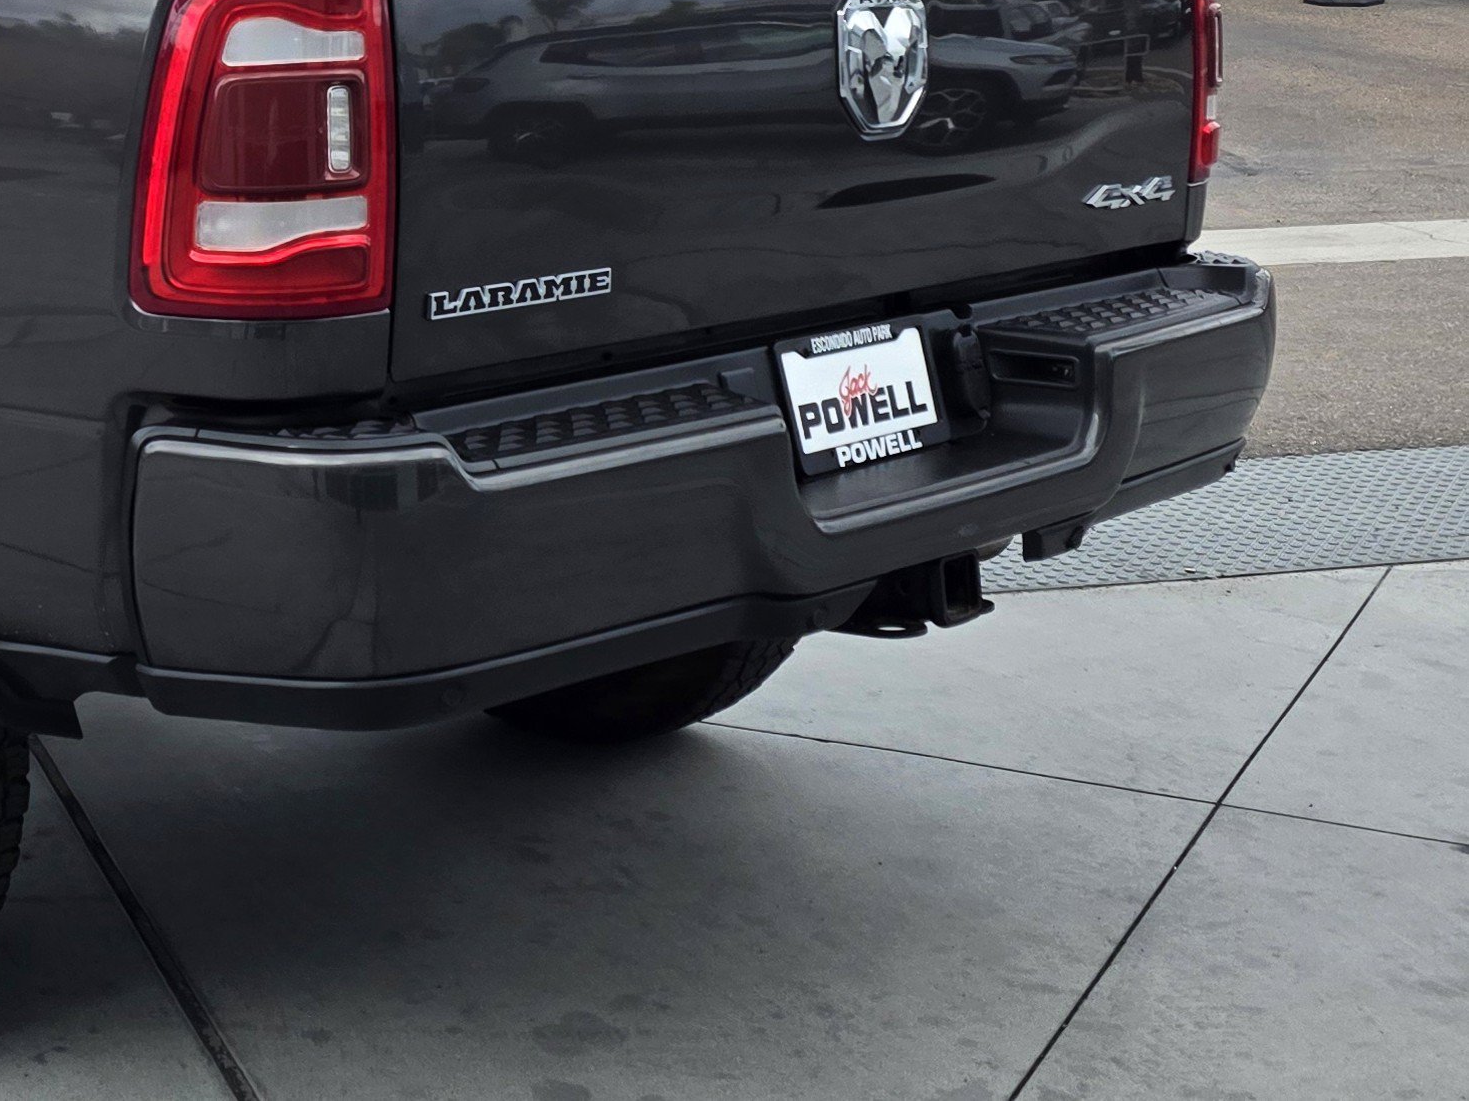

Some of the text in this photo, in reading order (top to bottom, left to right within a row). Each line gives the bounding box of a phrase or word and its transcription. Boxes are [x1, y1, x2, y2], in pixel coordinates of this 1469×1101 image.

[427, 267, 612, 320] LARAMIE
[811, 324, 893, 354] ESCONDIDO AUTO PARK
[798, 381, 928, 441] POWELL
[838, 364, 878, 417] Jack
[835, 428, 923, 468] POWELL
